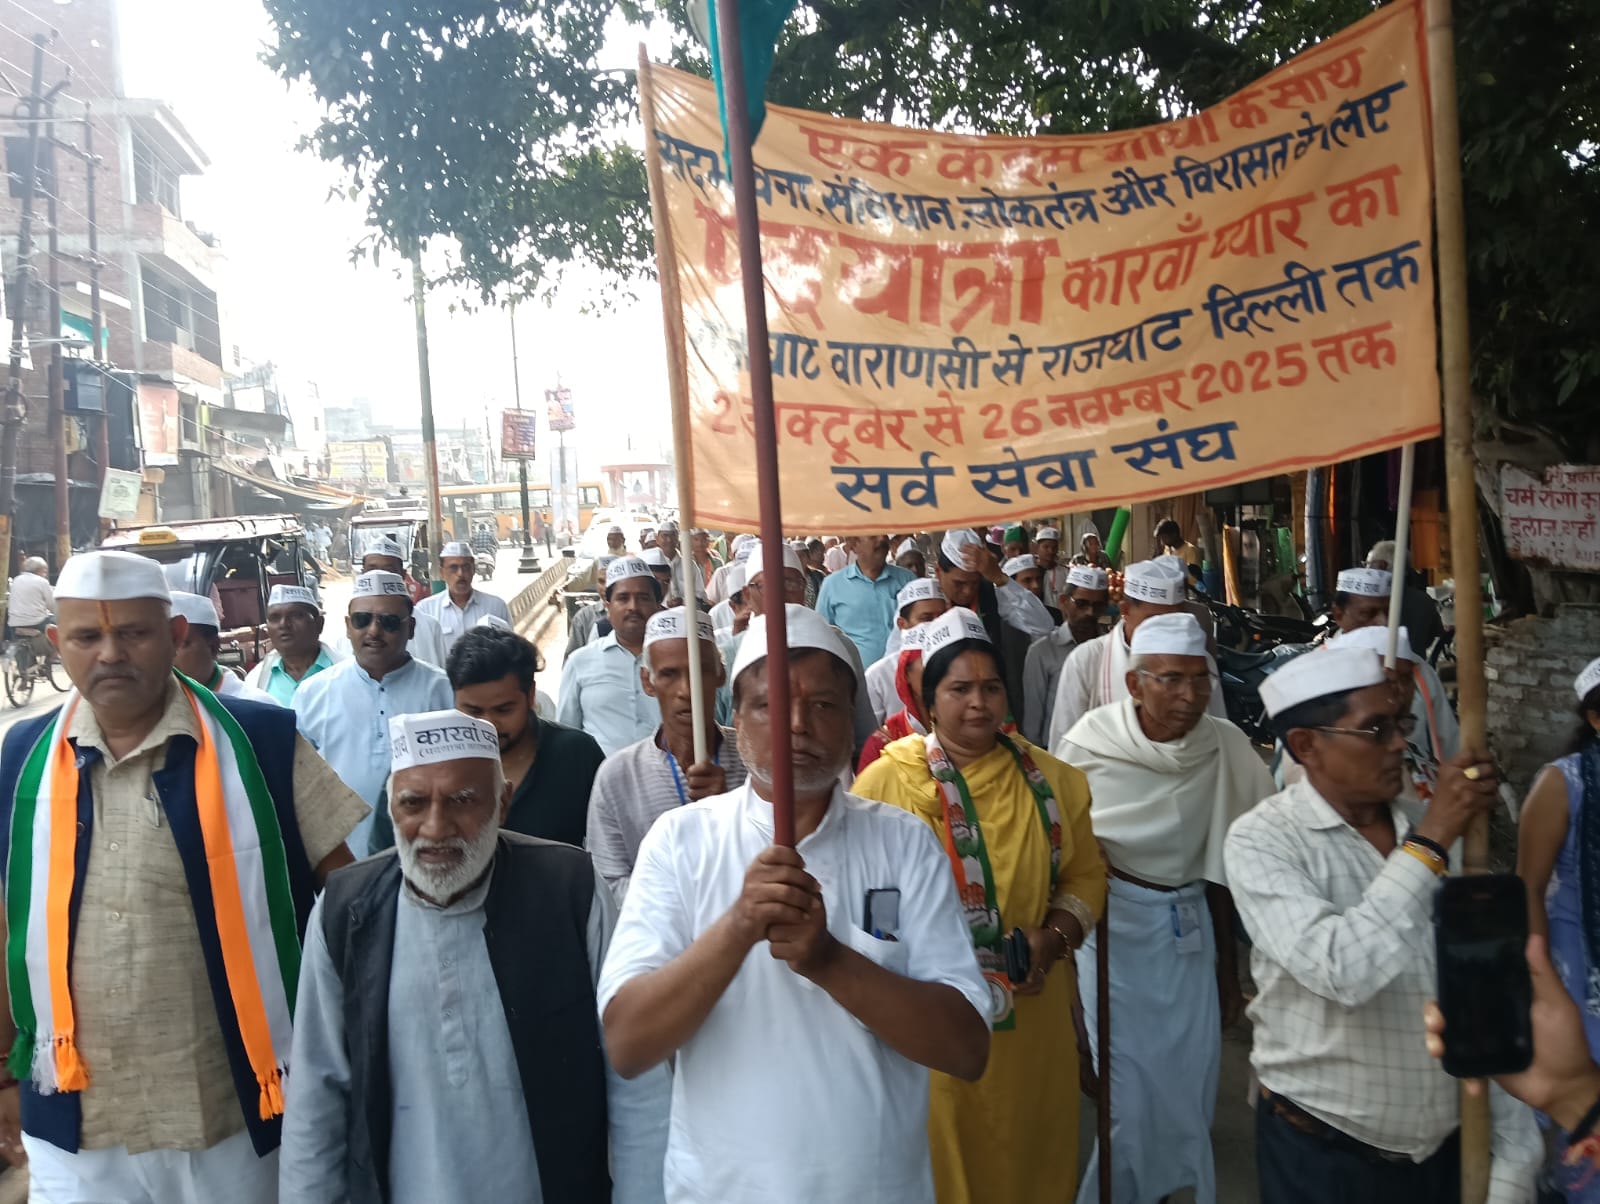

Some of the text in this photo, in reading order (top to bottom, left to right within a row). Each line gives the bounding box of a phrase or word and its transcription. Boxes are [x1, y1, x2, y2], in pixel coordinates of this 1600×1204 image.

[799, 126, 928, 178] एक
[1266, 47, 1366, 109] साथ
[1102, 166, 1176, 216] और
[1172, 131, 1296, 200] विरासत
[1062, 213, 1208, 311] कारवाँ
[1209, 193, 1313, 259] प्यार
[1325, 164, 1402, 227] का
[826, 335, 991, 391] वाराणसी
[991, 333, 1032, 386] से
[1040, 308, 1193, 381] राजघाट
[1202, 260, 1327, 340] दिल्ली
[1331, 240, 1422, 308] तक
[923, 390, 965, 446] से
[977, 396, 1043, 440] 26
[1046, 368, 1193, 431] नवम्बर
[1191, 342, 1308, 404] 2025
[1312, 320, 1397, 383] तक
[830, 418, 1240, 513] सर्व सेवा संघ
[415, 722, 480, 745] कारवां
